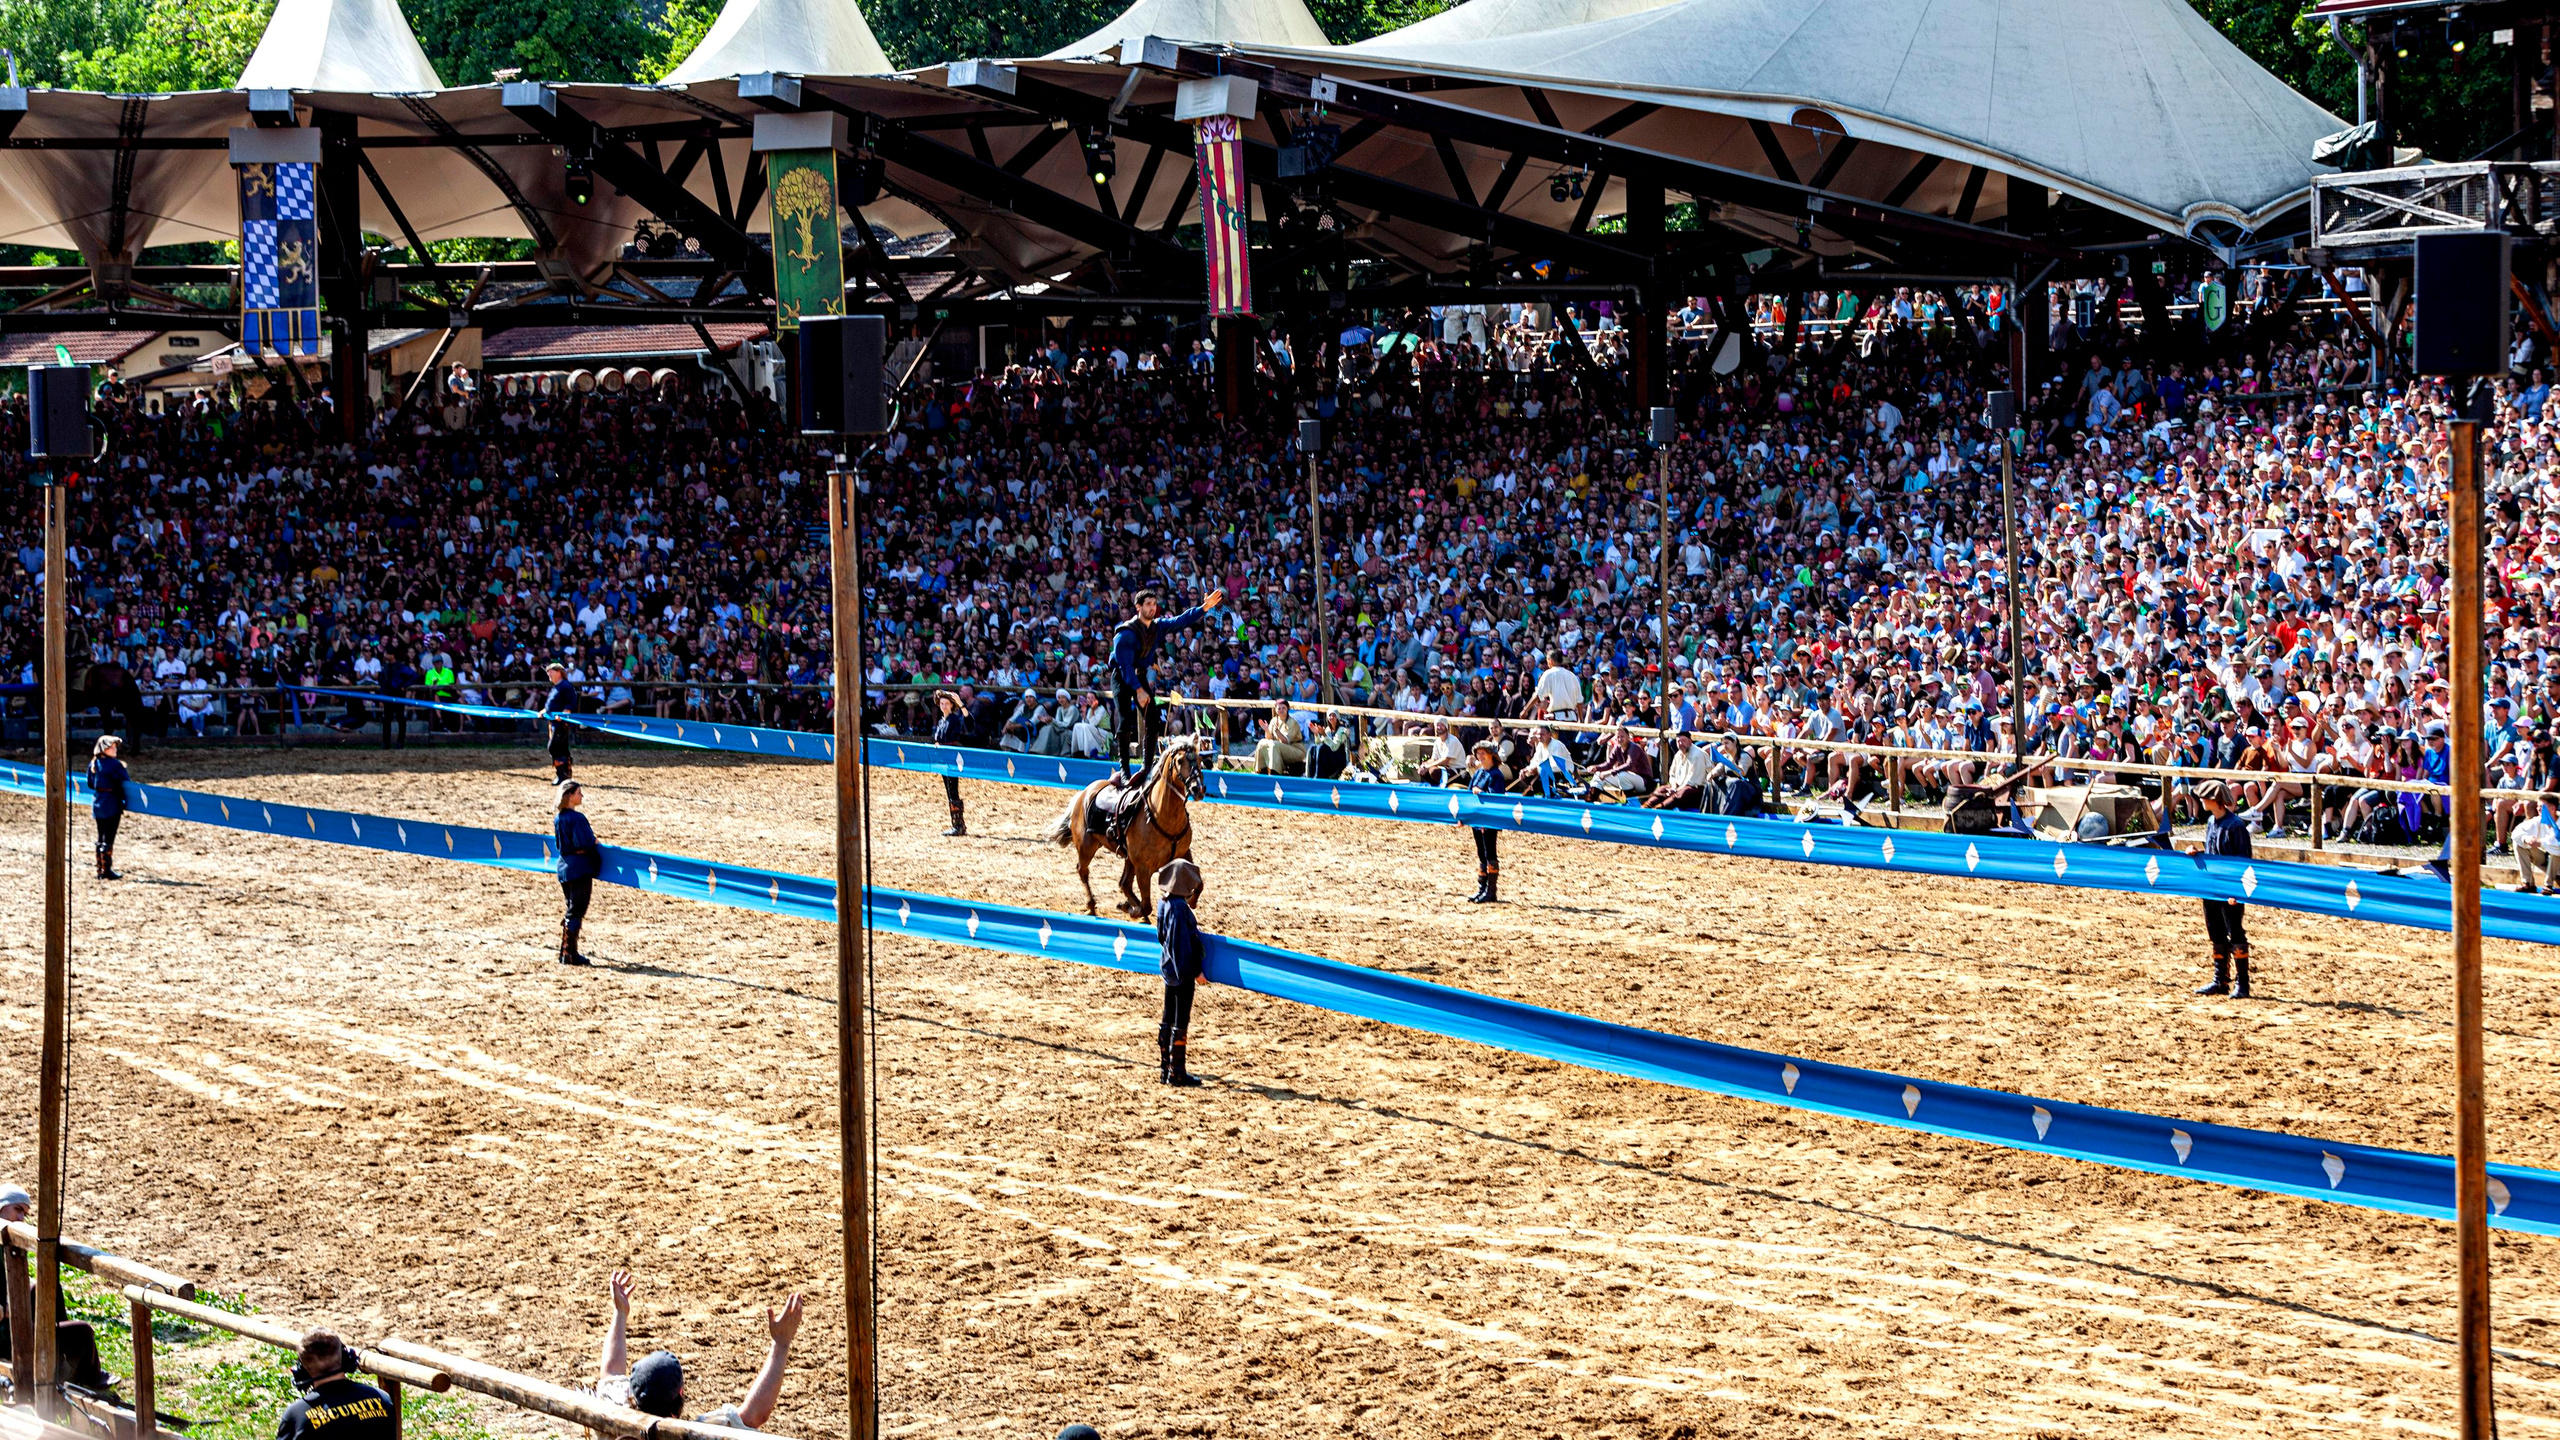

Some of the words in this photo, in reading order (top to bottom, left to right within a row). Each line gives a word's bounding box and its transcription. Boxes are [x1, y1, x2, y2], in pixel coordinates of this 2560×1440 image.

[2077, 299, 2092, 328] H
[2206, 289, 2223, 321] G
[310, 1397, 384, 1430] SECURITY
[358, 1409, 388, 1421] SERVICE
